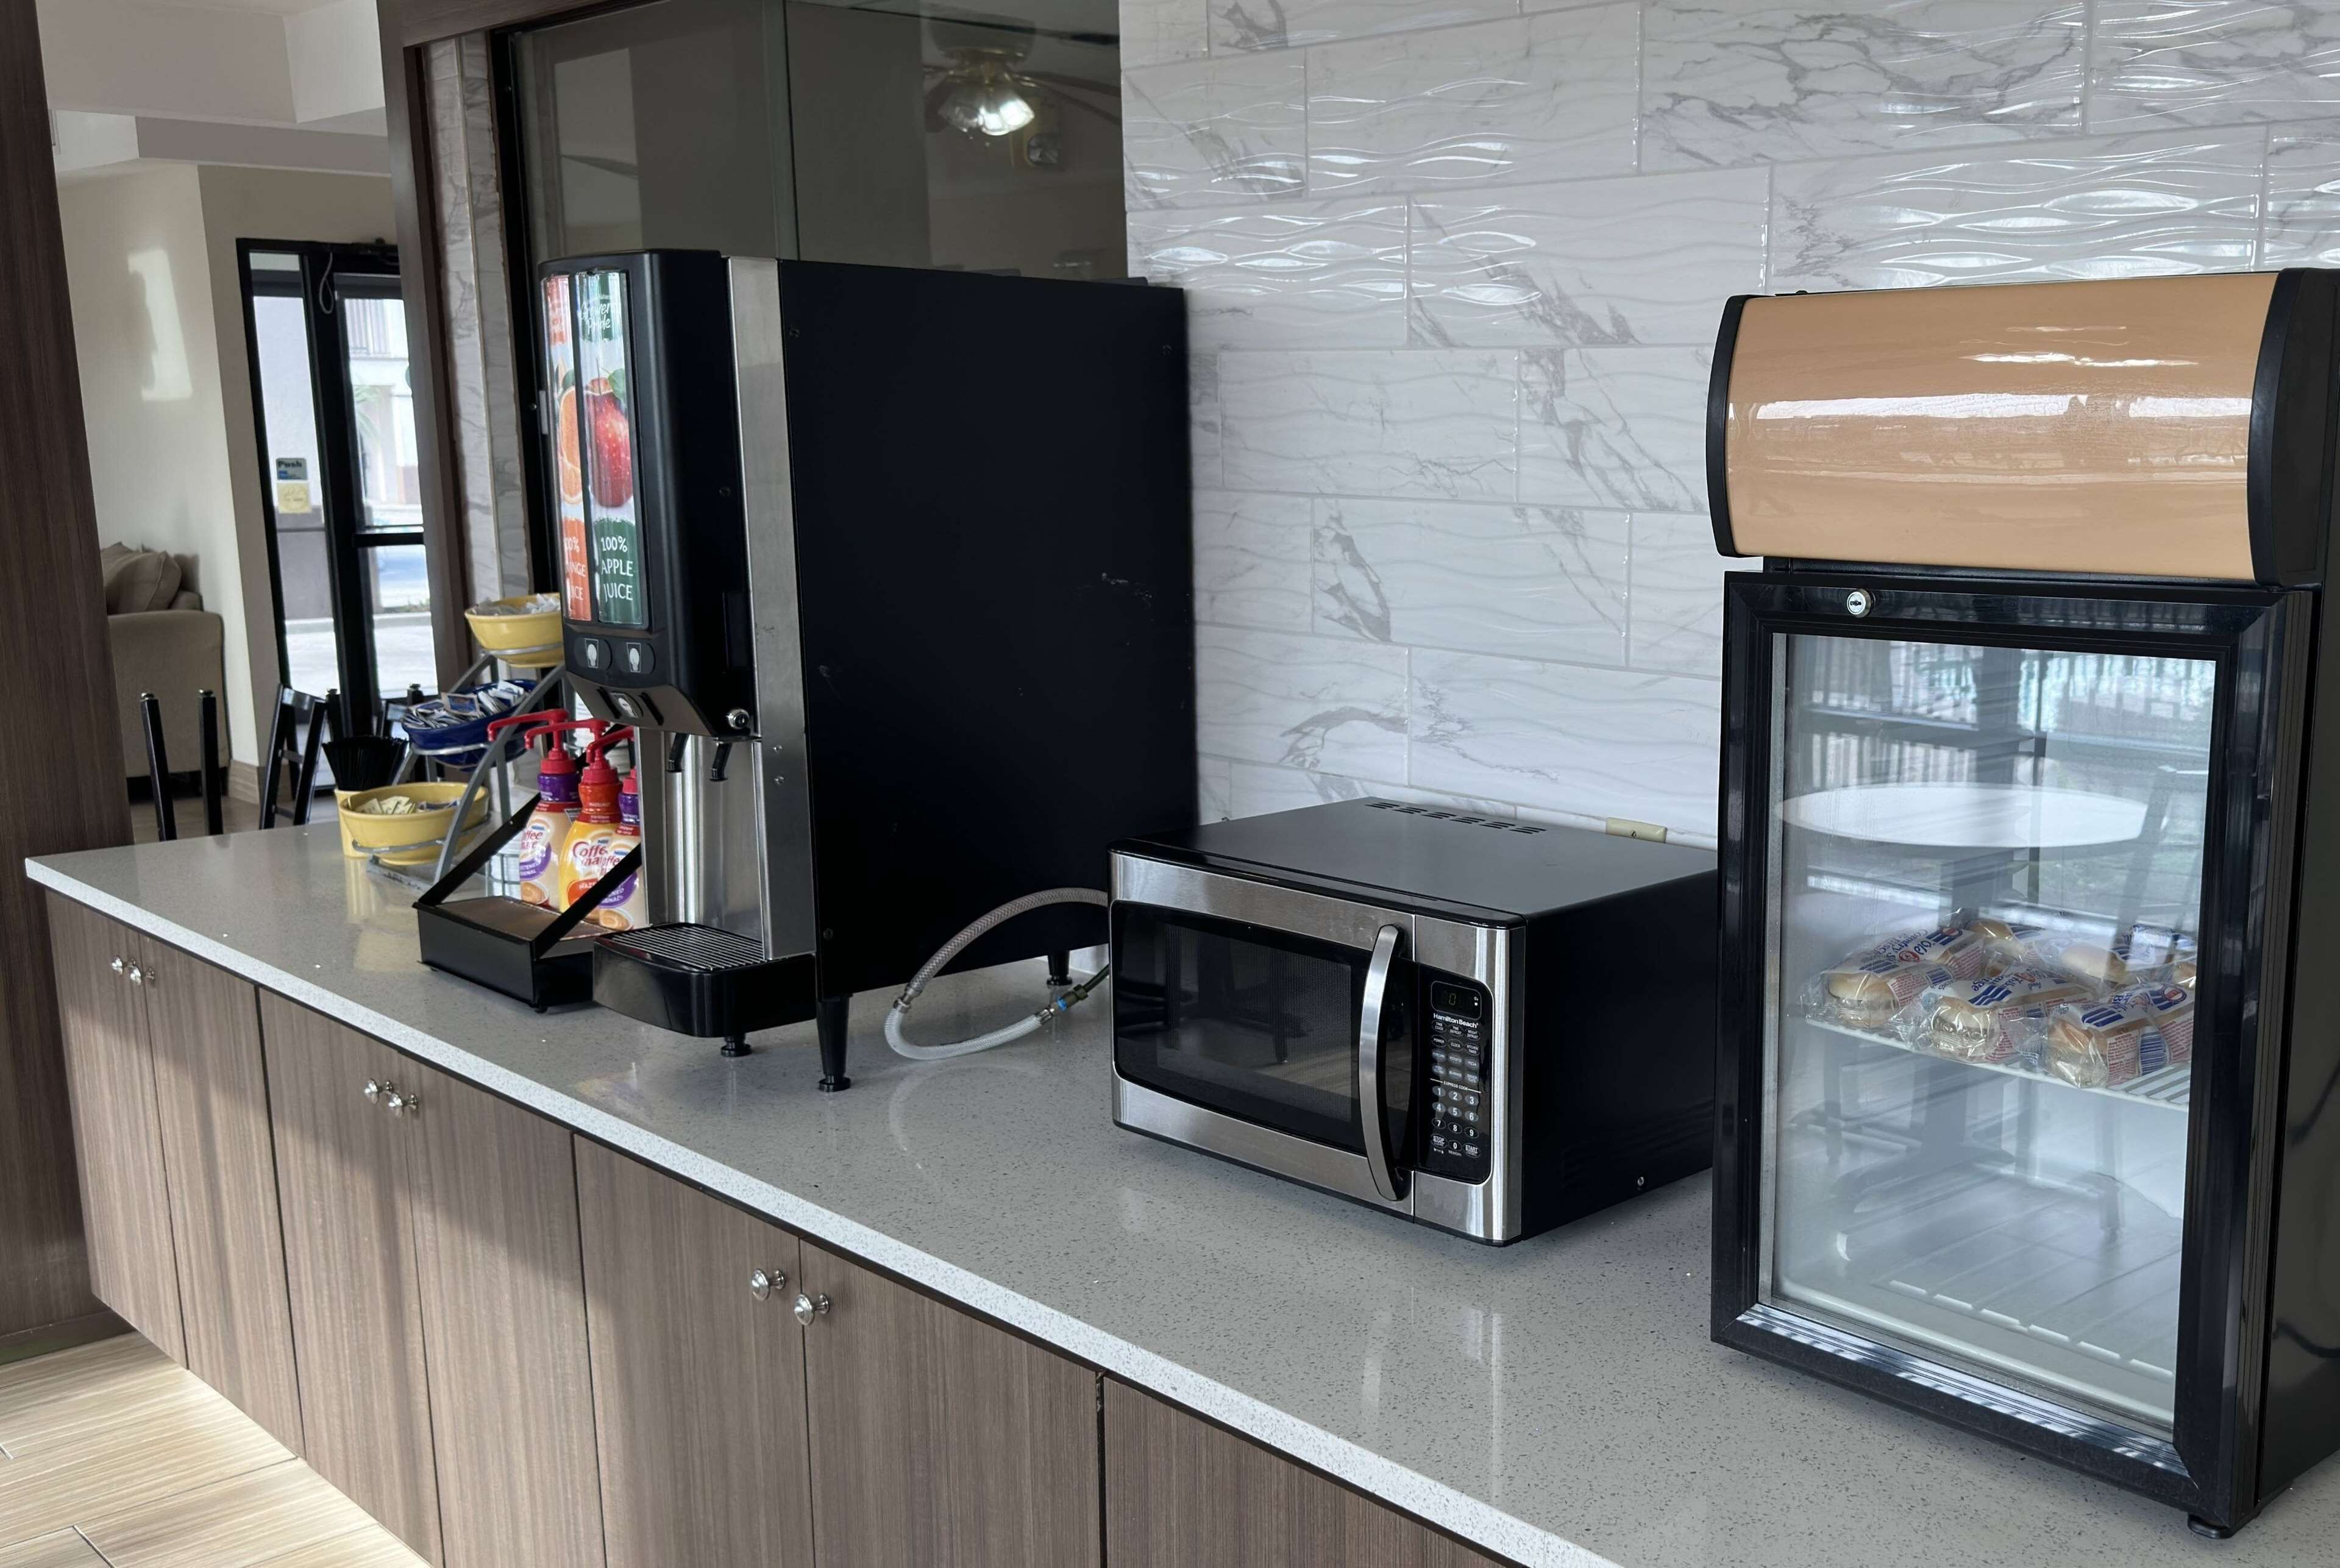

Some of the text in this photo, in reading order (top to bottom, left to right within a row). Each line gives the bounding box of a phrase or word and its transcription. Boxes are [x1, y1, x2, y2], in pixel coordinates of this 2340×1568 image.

[564, 536, 580, 553] 00%
[600, 536, 628, 553] 100%
[600, 558, 634, 577] APPLE
[570, 584, 584, 600] UICE
[603, 582, 633, 603] JUICE
[524, 830, 543, 840] ffee
[573, 841, 608, 859] Coffe
[1914, 941, 1932, 956] Old
[1434, 1013, 1459, 1024] Hamilton
[1469, 1112, 1474, 1121] 6
